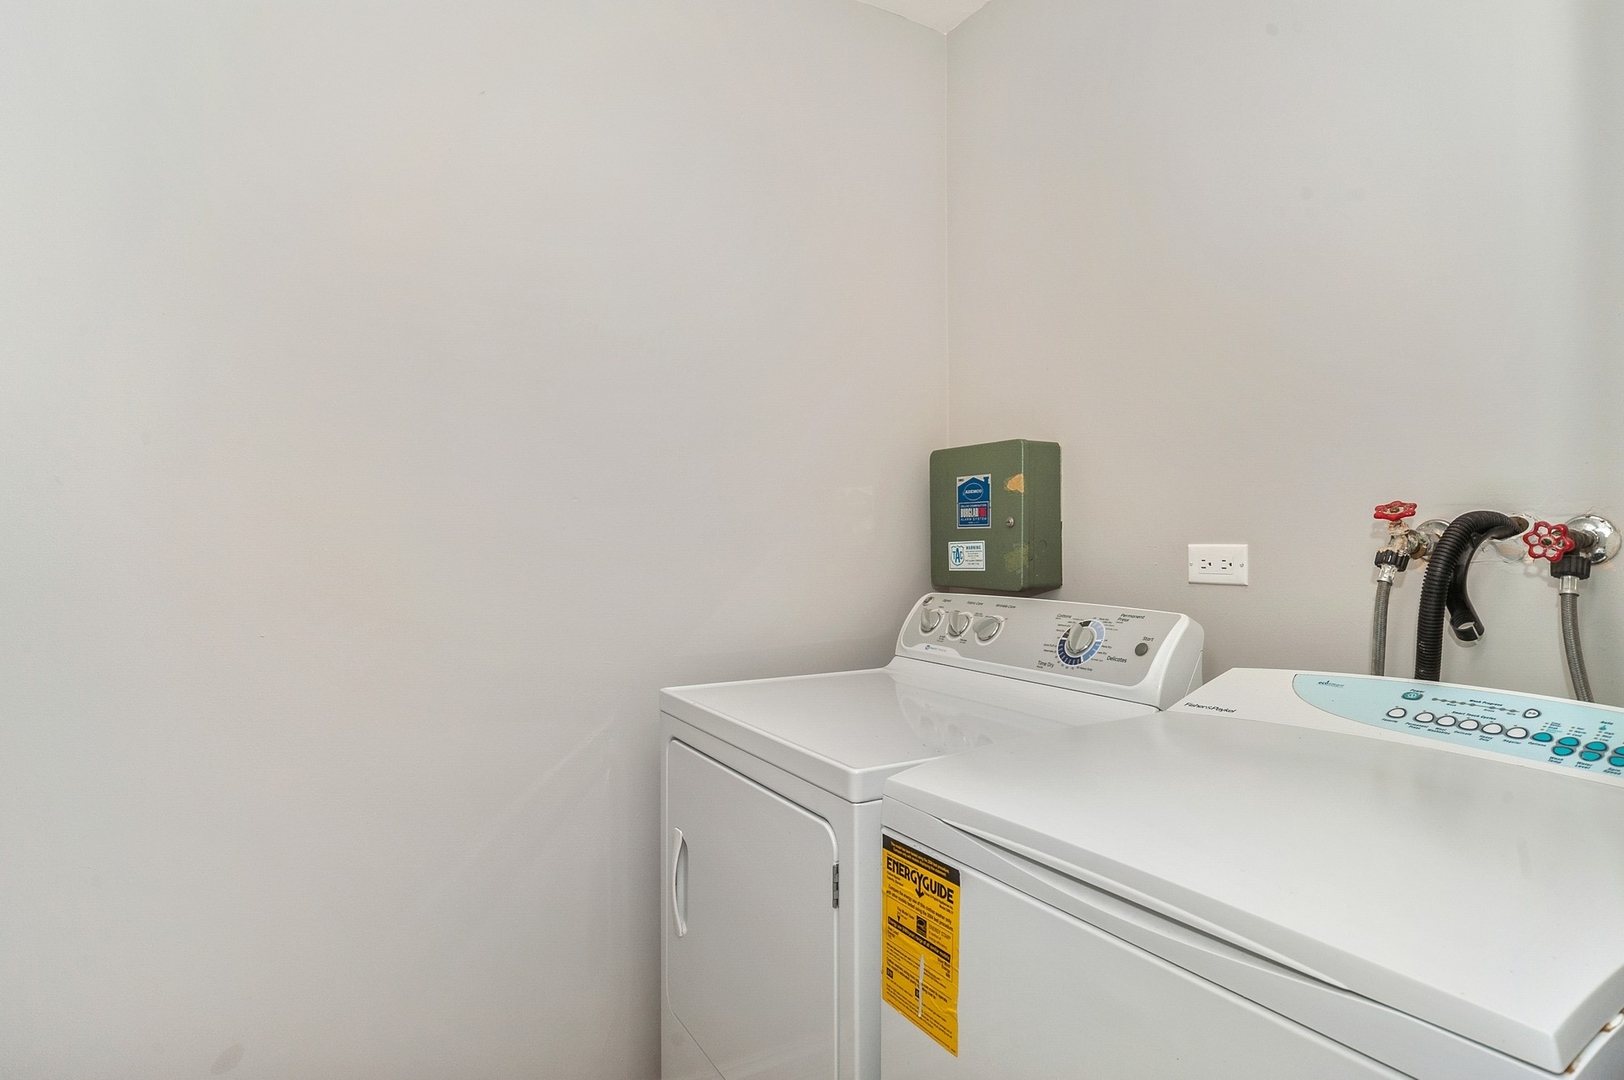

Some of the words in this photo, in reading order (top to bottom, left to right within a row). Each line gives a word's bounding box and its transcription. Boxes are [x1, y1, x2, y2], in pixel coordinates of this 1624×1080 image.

[1106, 655, 1128, 664] Delicates
[1046, 661, 1055, 669] Dry
[886, 856, 955, 905] ENERGYGUIDE
